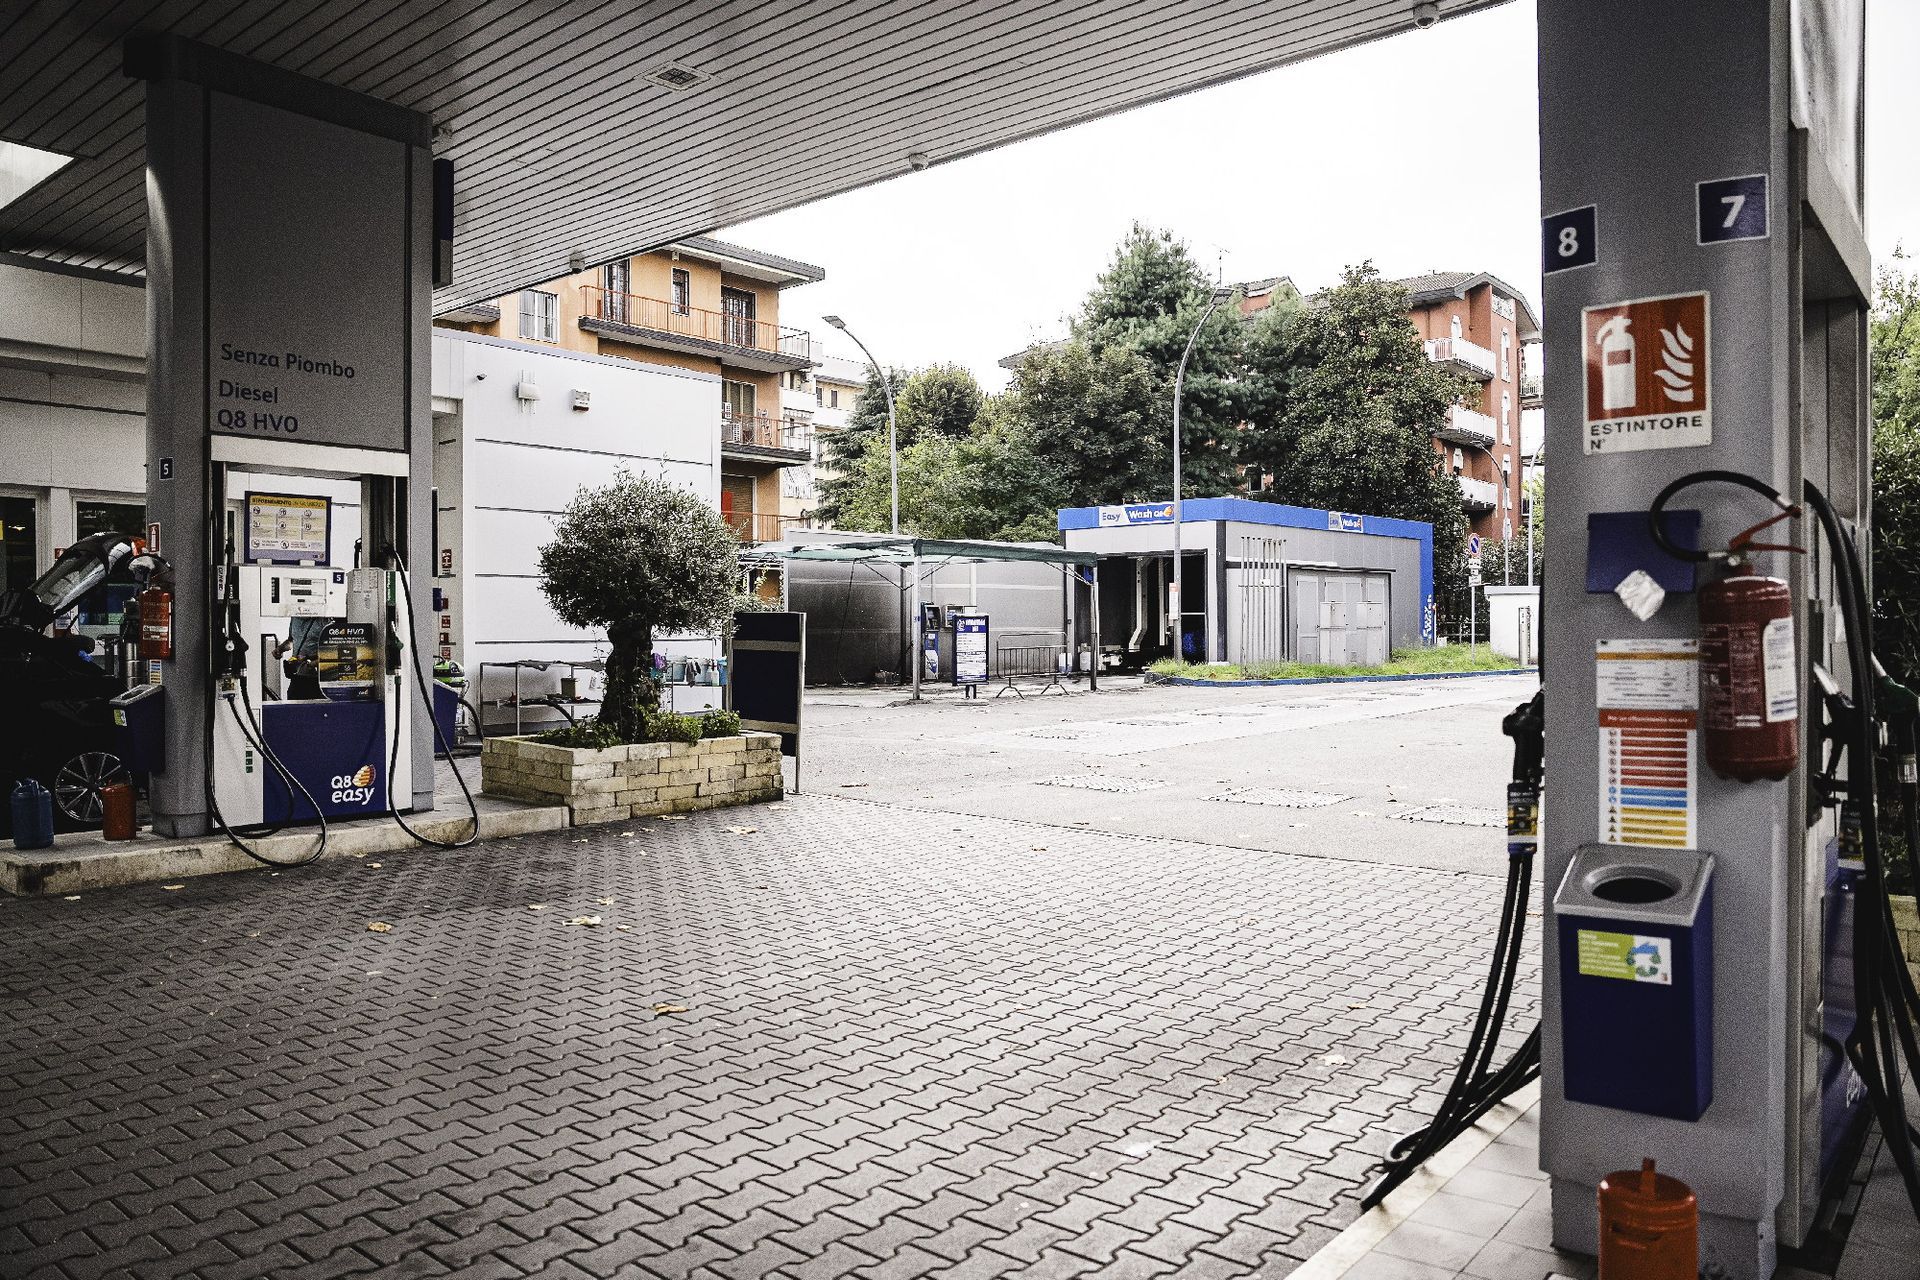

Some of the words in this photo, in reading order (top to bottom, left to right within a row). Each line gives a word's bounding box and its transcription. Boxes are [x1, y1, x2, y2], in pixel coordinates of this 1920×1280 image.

[1720, 194, 1746, 228] 7
[1558, 227, 1579, 257] 8
[221, 343, 280, 368] Senza
[286, 352, 355, 379] Piombo
[219, 379, 278, 404] Diesel
[217, 408, 247, 430] Q8
[253, 412, 299, 433] HVO
[1590, 415, 1703, 437] ESTINTORE
[163, 463, 169, 475] 5
[1102, 512, 1121, 522] Easy
[1128, 508, 1153, 519] Wash
[335, 574, 342, 582] 5
[330, 775, 352, 789] Q8
[331, 787, 375, 806] easy
